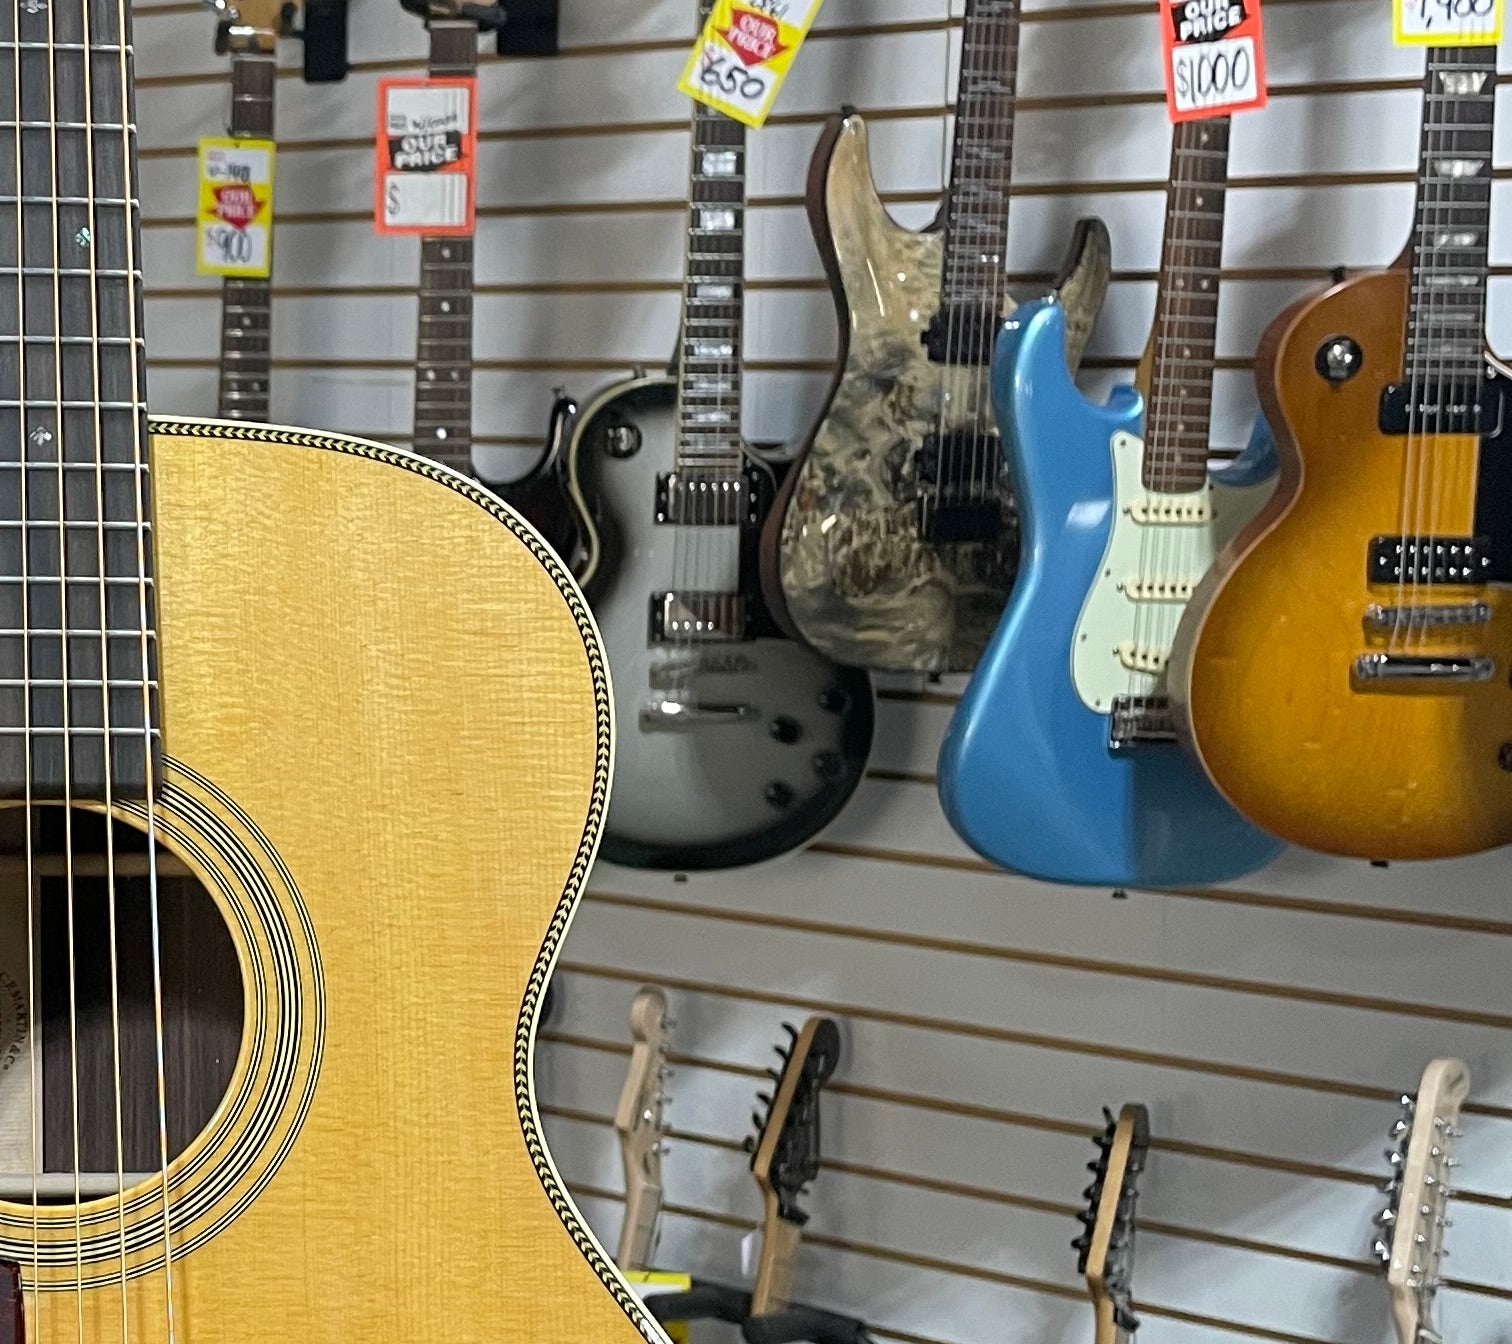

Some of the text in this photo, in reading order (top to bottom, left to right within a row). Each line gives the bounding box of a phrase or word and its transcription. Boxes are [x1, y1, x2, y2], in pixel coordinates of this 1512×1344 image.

[1179, 4, 1243, 43] PRICE
[1175, 47, 1251, 106] $1000
[394, 144, 459, 169] PRICE
[401, 133, 448, 153] OUR
